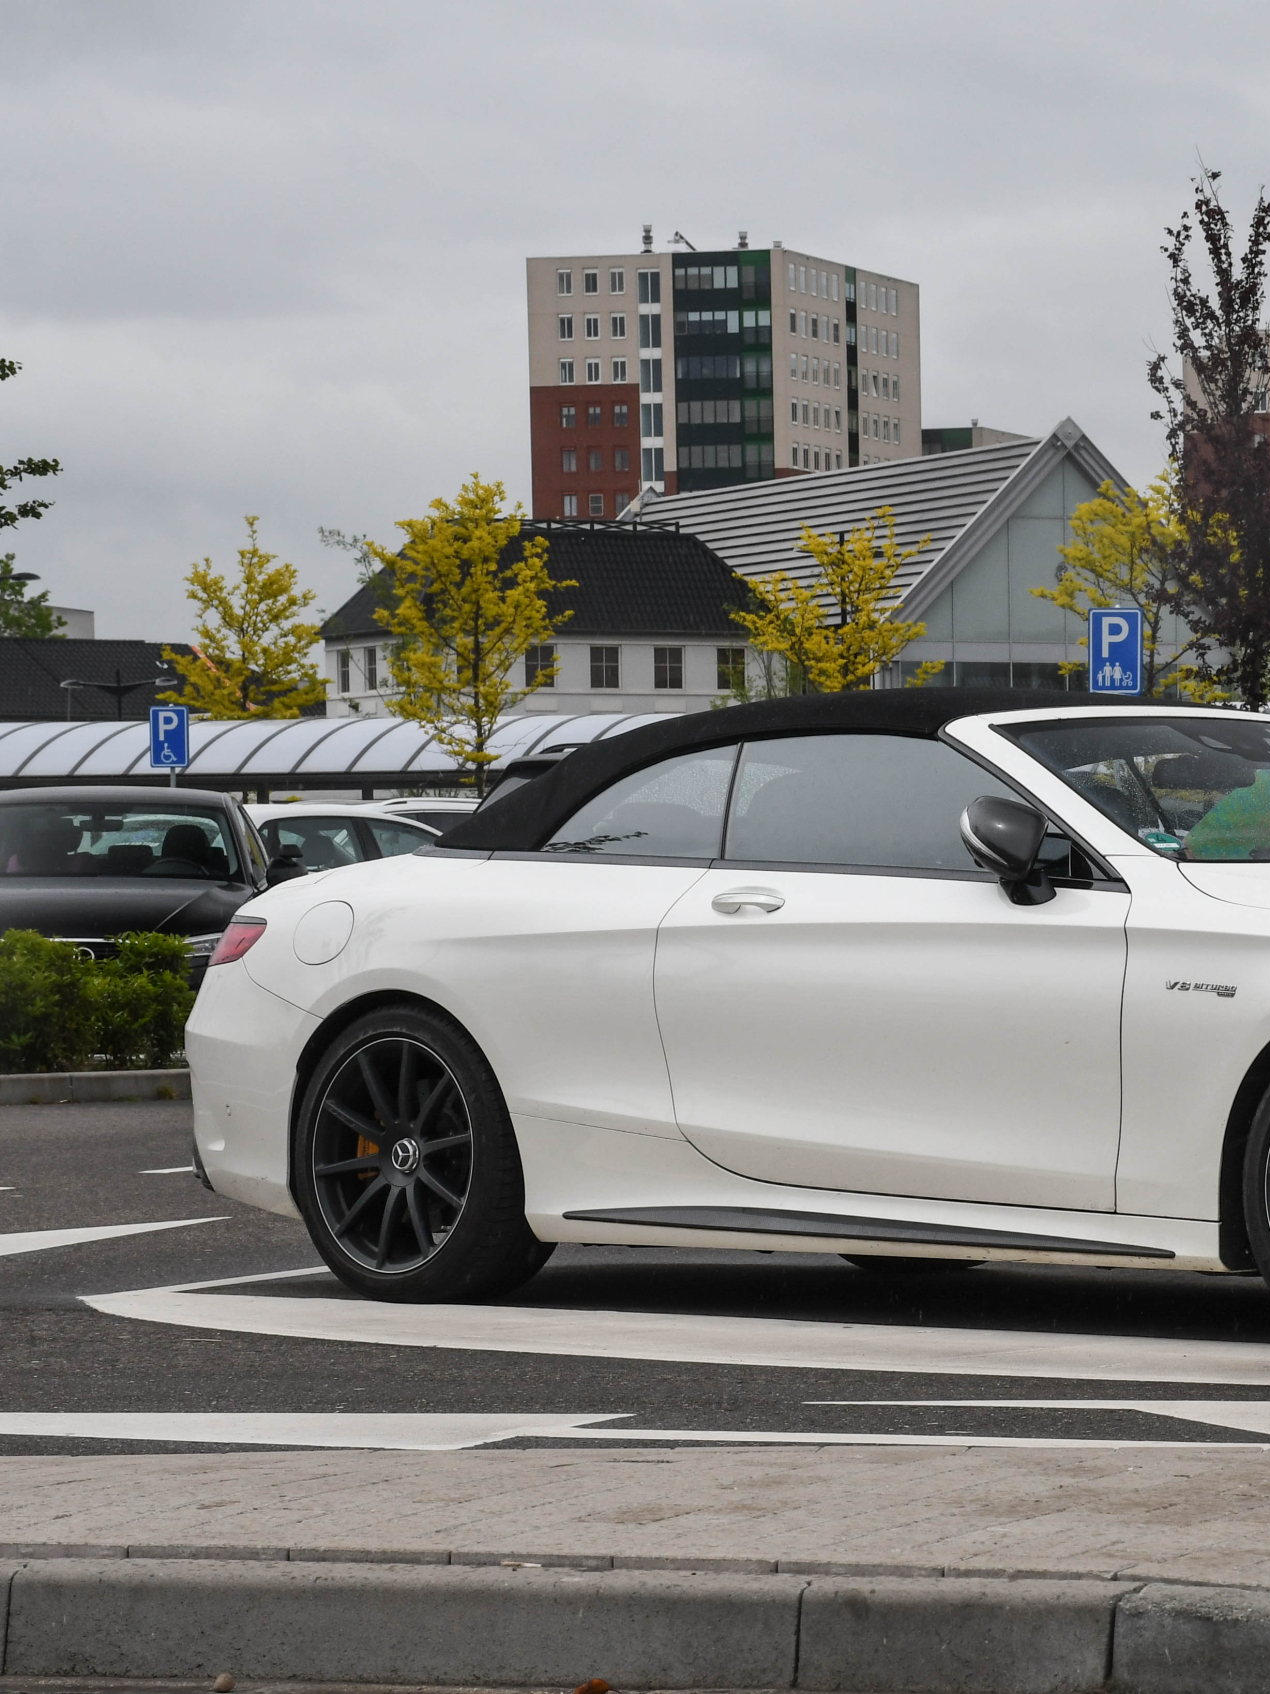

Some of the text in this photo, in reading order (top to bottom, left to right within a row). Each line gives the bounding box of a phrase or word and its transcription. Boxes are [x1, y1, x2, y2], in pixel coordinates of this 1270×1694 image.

[1102, 616, 1129, 658] P
[158, 711, 178, 741] P
[1165, 979, 1238, 992] V8 BITURBO
